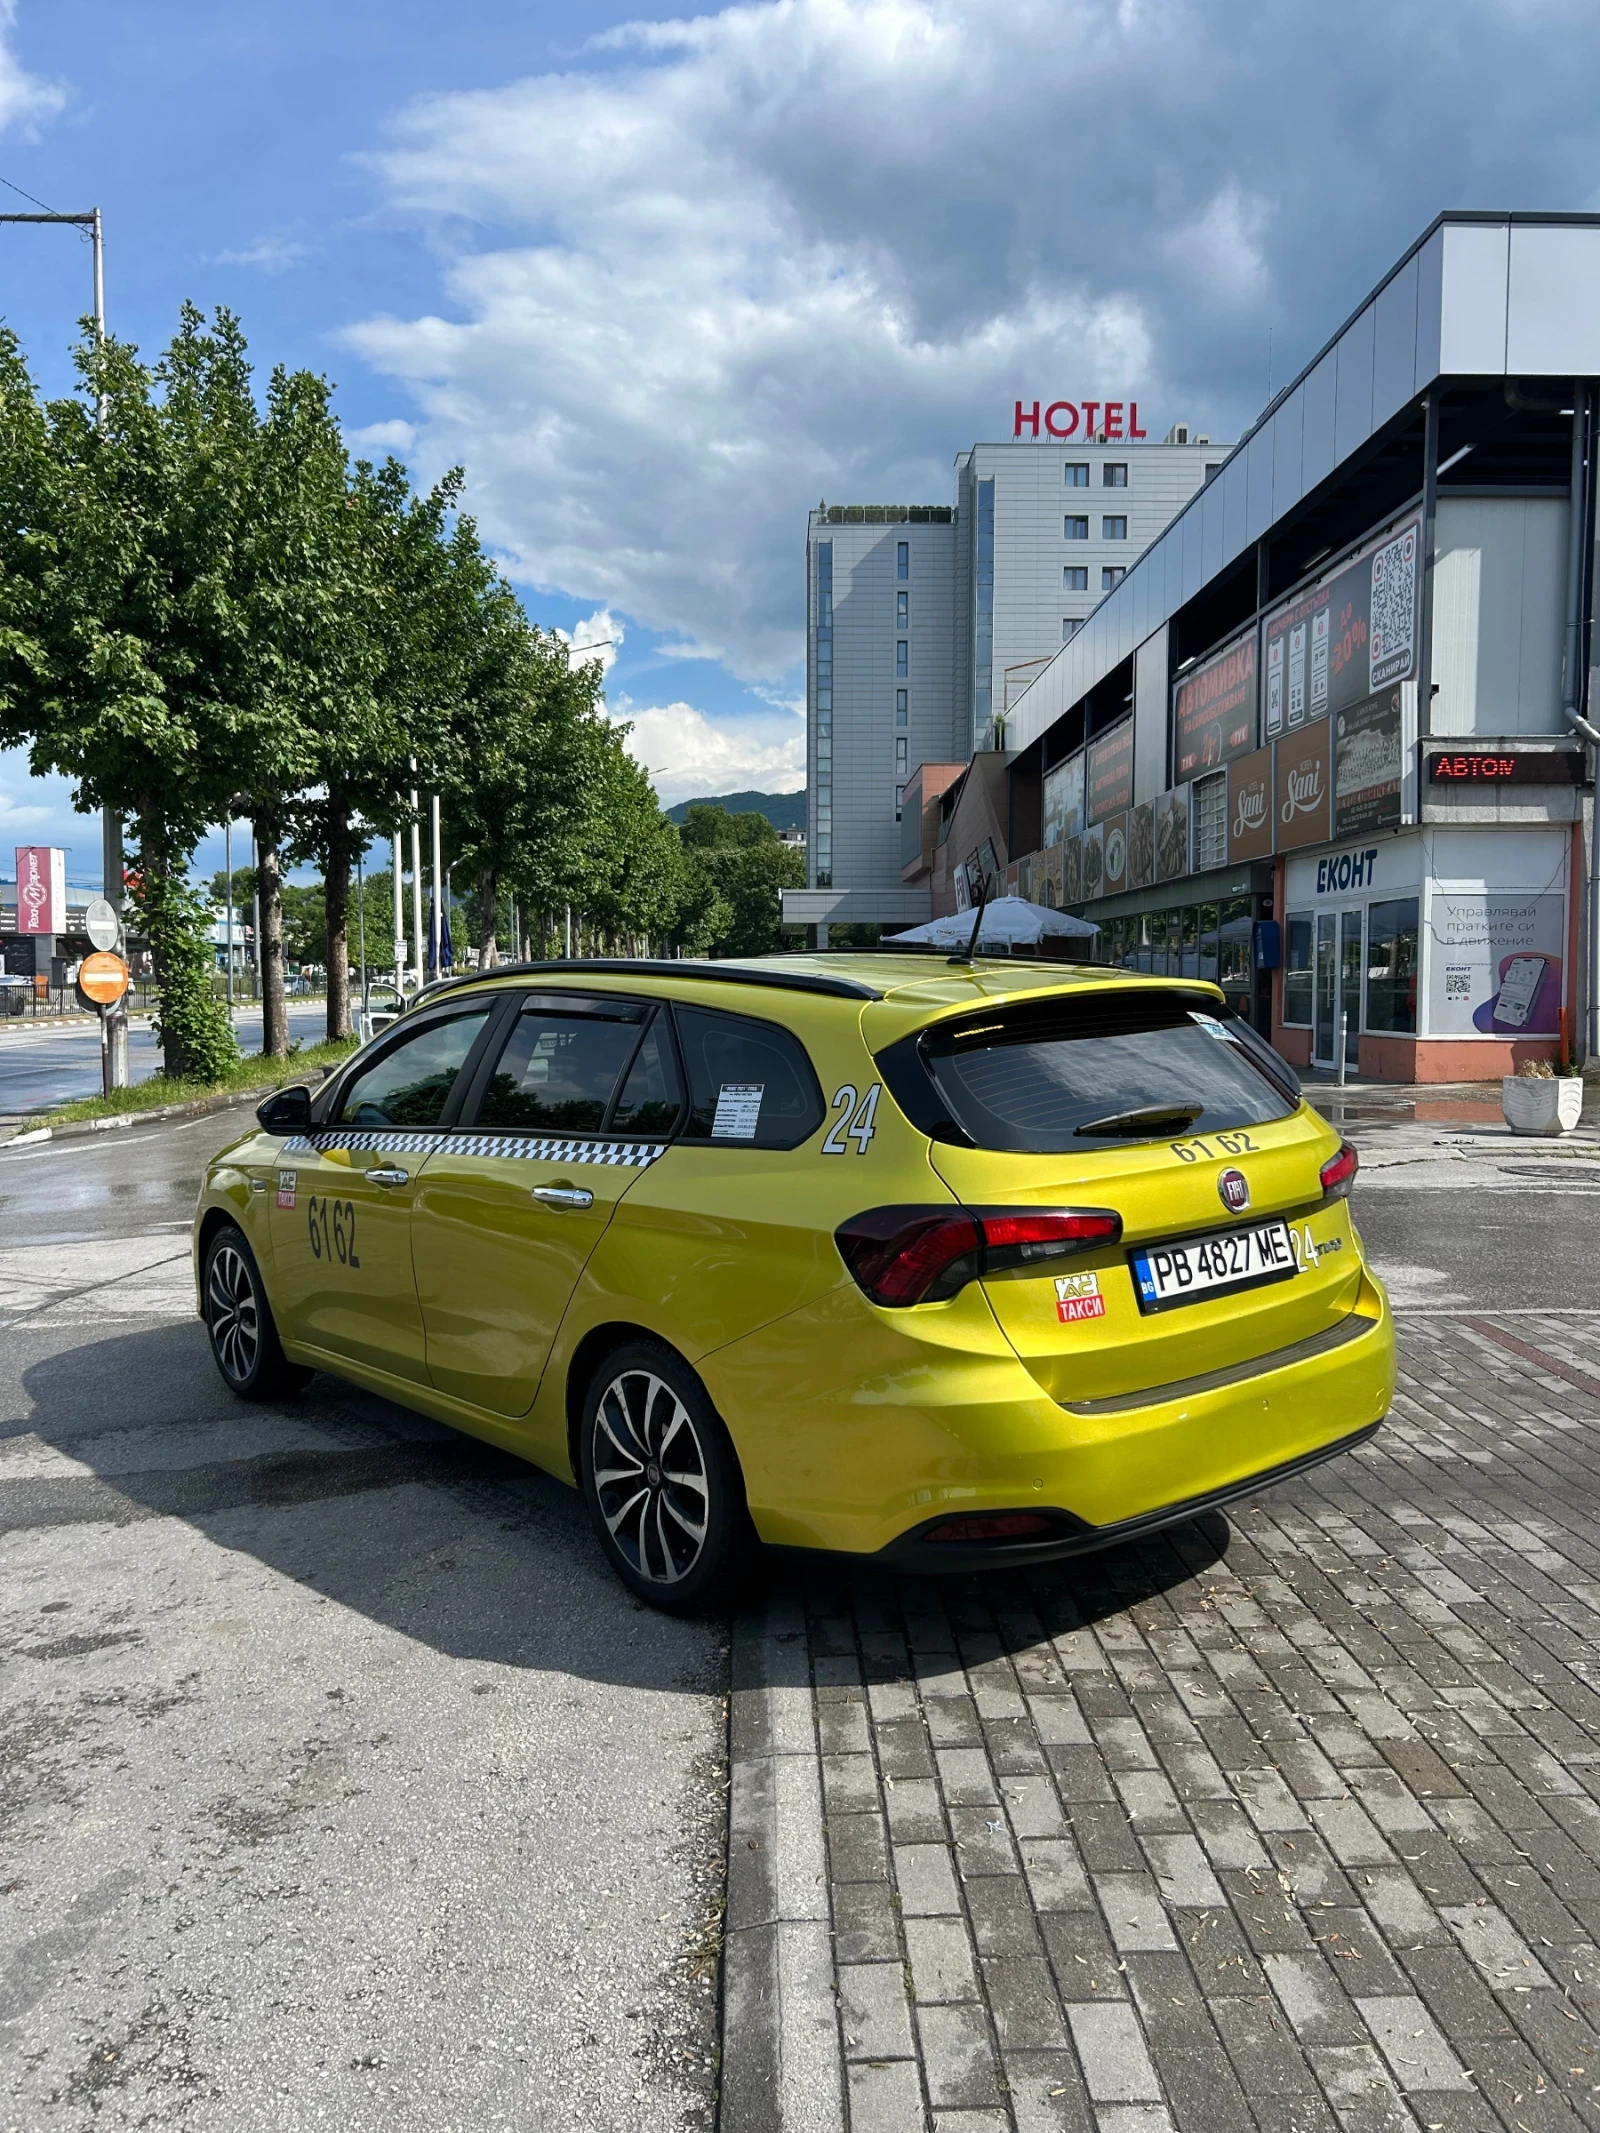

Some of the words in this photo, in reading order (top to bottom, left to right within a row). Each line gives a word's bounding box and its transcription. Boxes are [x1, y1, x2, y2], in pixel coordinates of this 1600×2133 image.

[1014, 401, 1147, 438] HOTEL
[1178, 642, 1254, 719] АВТОМИВКА
[1372, 653, 1410, 683] СКАНИРАЙ
[1234, 728, 1247, 745] ТУК
[1182, 755, 1193, 769] ТУК
[1281, 760, 1325, 822] Sani
[1233, 782, 1268, 837] Sani
[1316, 849, 1378, 893] ЕКОНТ
[1447, 905, 1536, 919] Управлявай
[1447, 922, 1513, 933] пратките
[1518, 922, 1535, 931] си
[1447, 937, 1455, 945] в
[1459, 936, 1533, 946] движение
[821, 1083, 882, 1155] 24
[1170, 1140, 1215, 1162] 61
[1215, 1132, 1260, 1154] 62
[1226, 1180, 1245, 1200] FIAT
[1141, 1281, 1155, 1294] BG
[1153, 1248, 1193, 1291] PB
[1198, 1233, 1250, 1280] 4827
[1255, 1227, 1288, 1267] ME
[1290, 1224, 1319, 1272] 24
[1060, 1297, 1104, 1321] ТАКСИ
